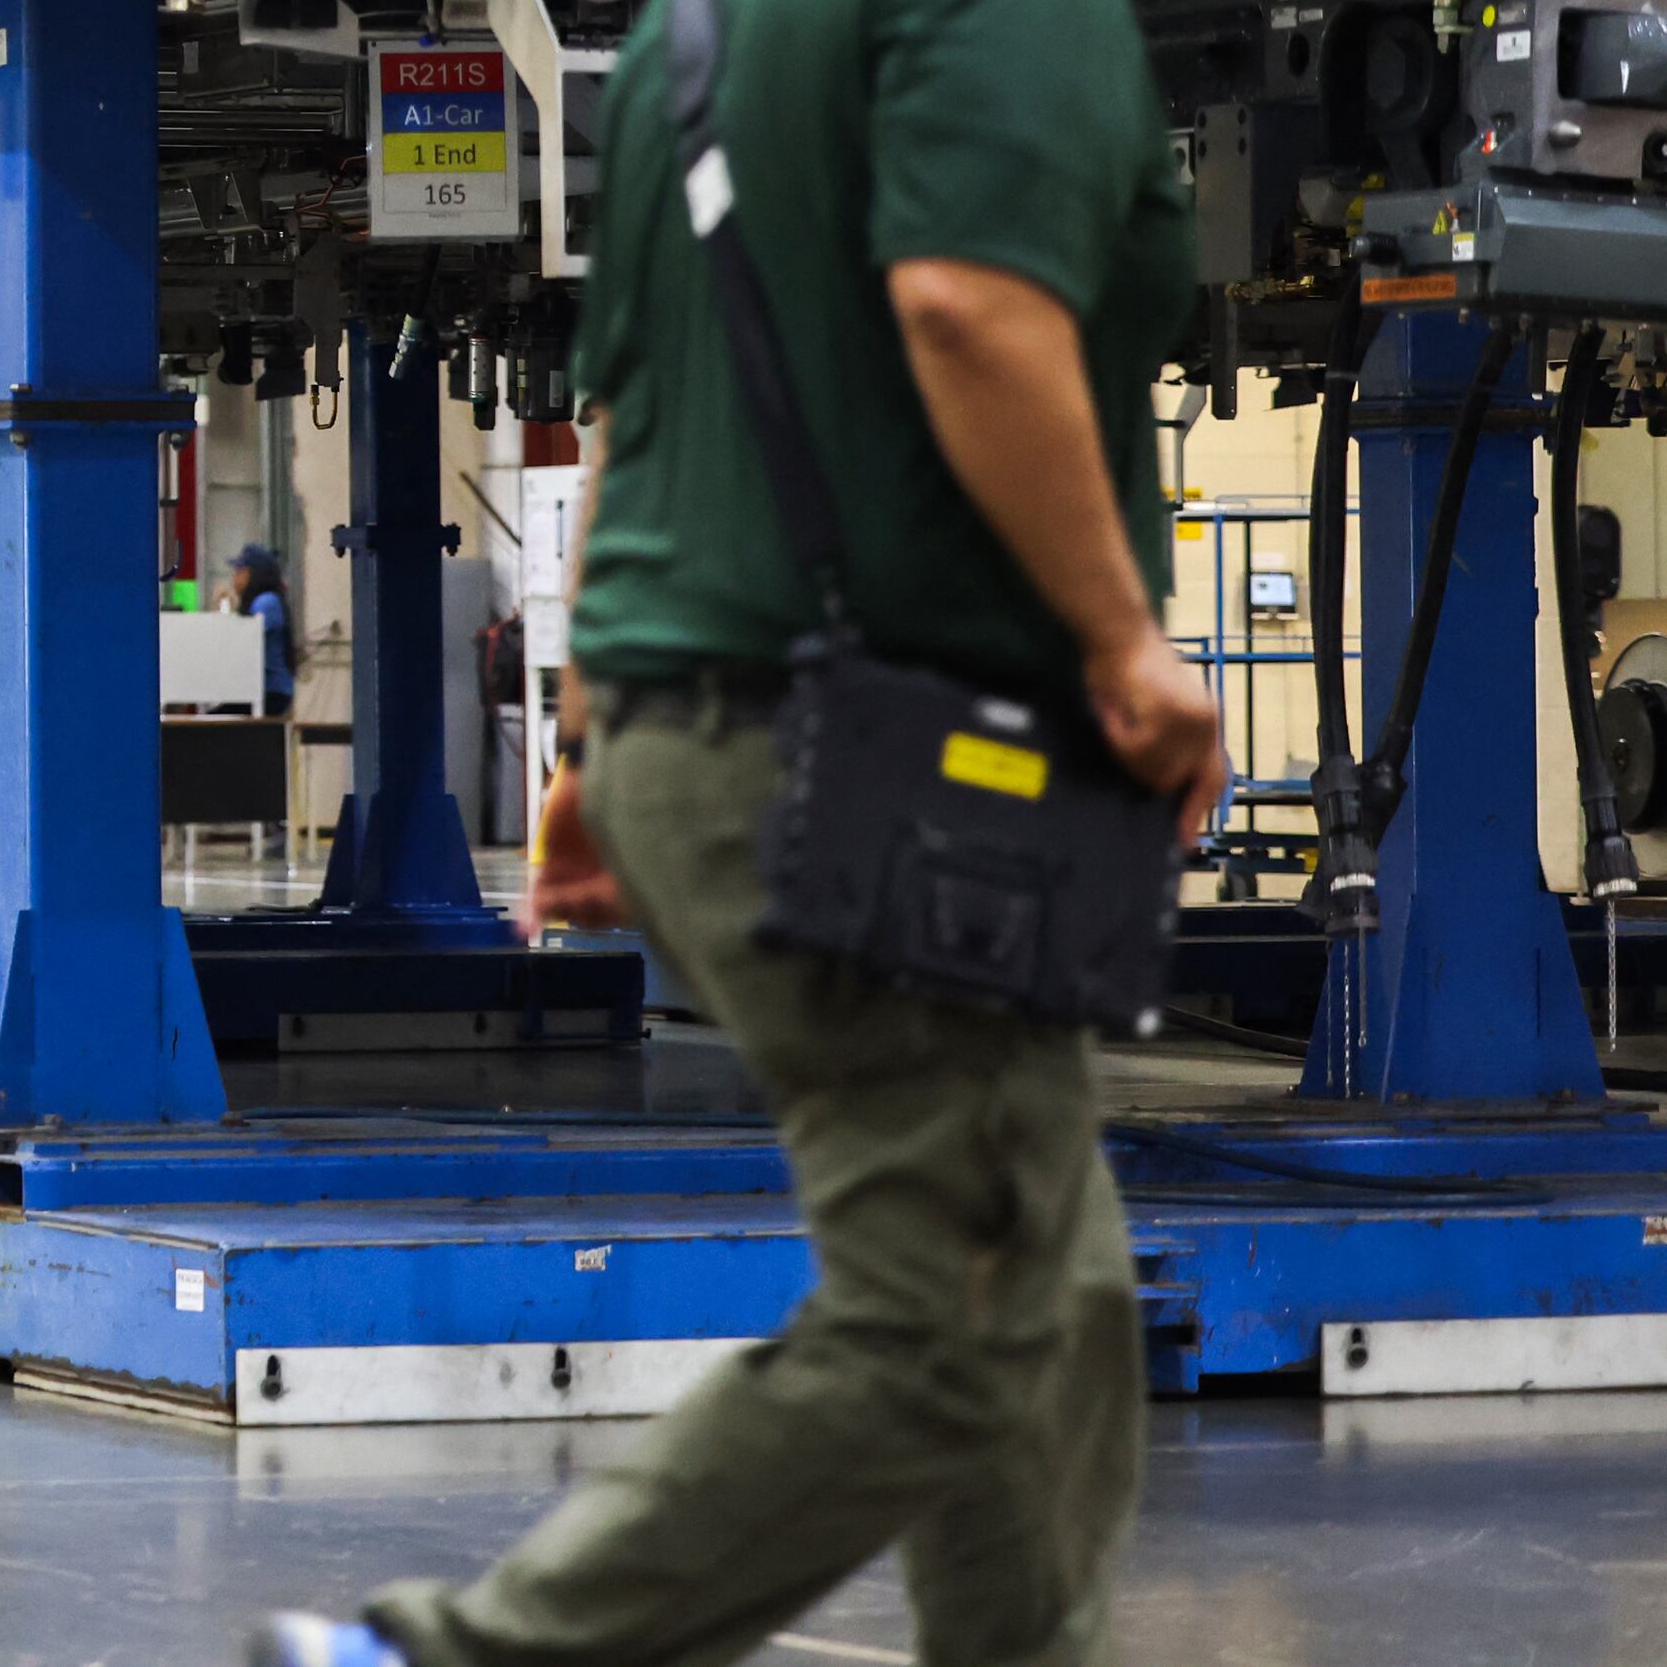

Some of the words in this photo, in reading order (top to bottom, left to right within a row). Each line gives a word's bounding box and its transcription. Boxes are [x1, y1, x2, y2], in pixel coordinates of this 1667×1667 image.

[399, 62, 486, 86] R211S
[404, 104, 483, 126] A1-Car
[414, 145, 425, 165] 1
[434, 143, 477, 165] End
[425, 184, 466, 205] 165
